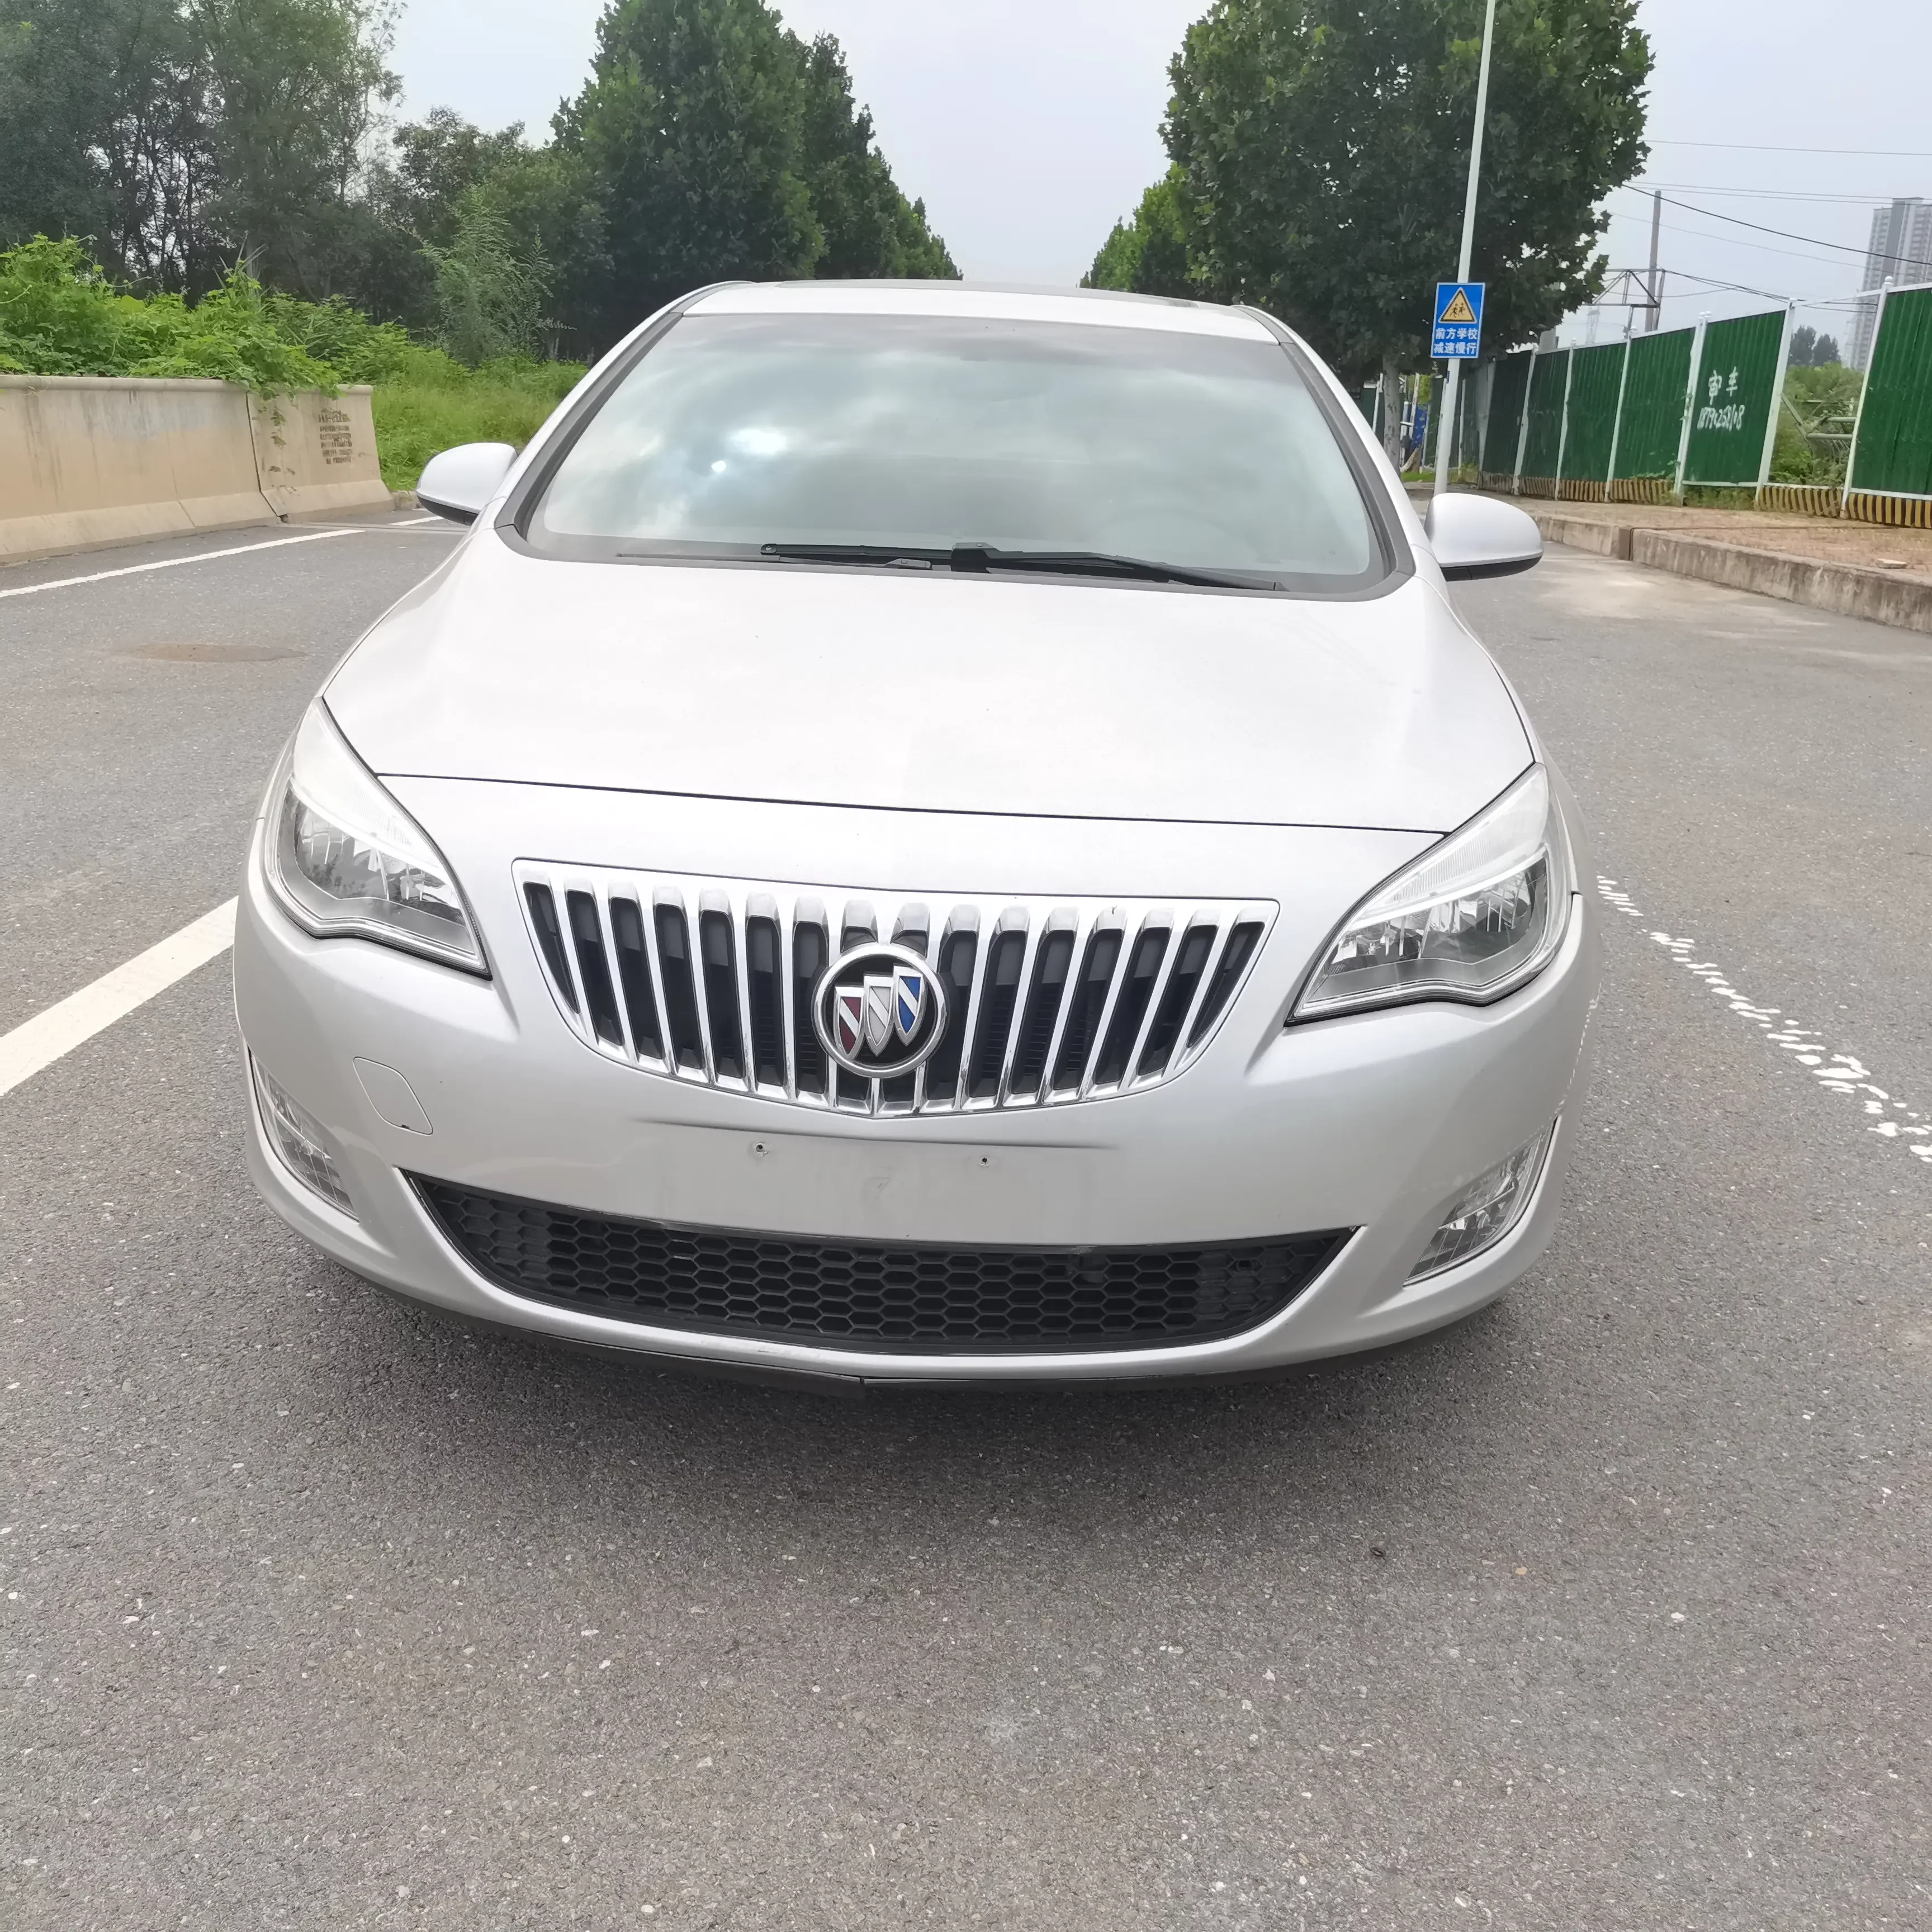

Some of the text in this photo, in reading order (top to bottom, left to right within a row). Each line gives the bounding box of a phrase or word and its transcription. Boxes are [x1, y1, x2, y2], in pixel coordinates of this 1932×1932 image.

[1436, 328, 1478, 340] 前方学校
[1433, 342, 1476, 354] 减速慢行
